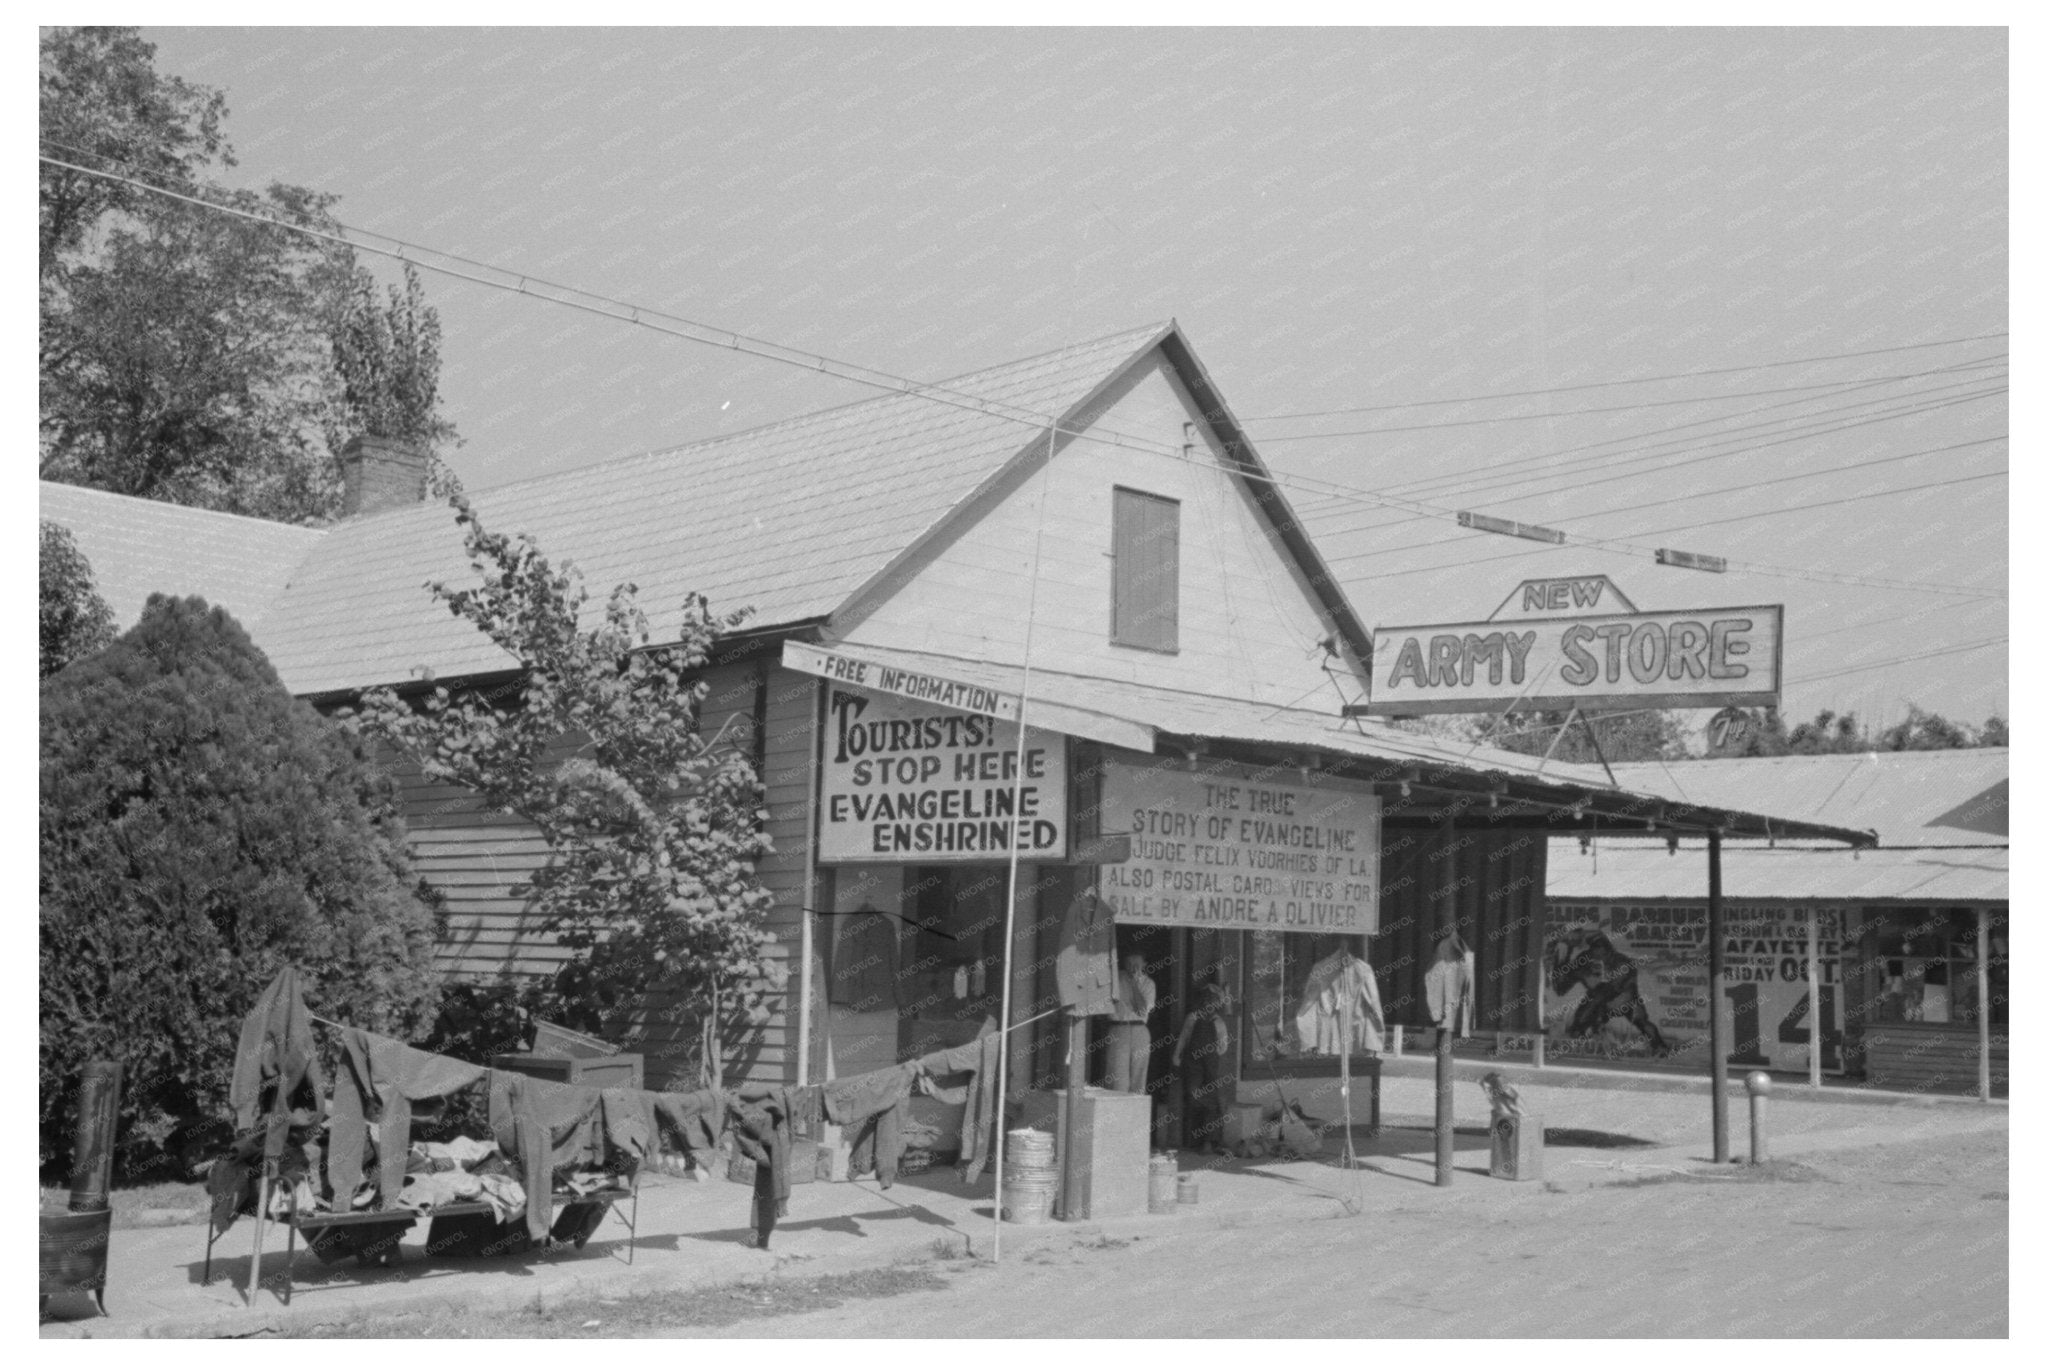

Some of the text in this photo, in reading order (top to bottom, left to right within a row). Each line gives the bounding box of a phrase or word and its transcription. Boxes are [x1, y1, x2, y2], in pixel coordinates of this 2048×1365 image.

[1522, 581, 1605, 612] NEW
[1388, 619, 1753, 688] ARMY STORE
[824, 656, 999, 713] FREE INFORMATION
[852, 755, 942, 786] STOP
[830, 787, 1039, 822] EVANGELINE
[1204, 784, 1295, 816] THE TRUE
[873, 819, 1058, 852] ENSHRINED
[1132, 808, 1356, 852] STORY OF EVANGELINE
[1132, 836, 1187, 863] JUDGE
[1194, 844, 1240, 867] FELIX
[1247, 849, 1318, 874] VOORHIES
[1325, 855, 1344, 876] OF
[1108, 866, 1154, 889] ALSO
[1161, 869, 1223, 893] POSTAL
[1291, 878, 1334, 900] VIEWS
[1344, 882, 1371, 902] FOR
[1109, 894, 1153, 917] SALE
[1160, 897, 1181, 919] BY
[1194, 898, 1259, 923] ANDRE
[1284, 900, 1357, 927] OLIVIER
[1726, 938, 1840, 956] AFAYETTE
[1724, 982, 1843, 1070] 14
